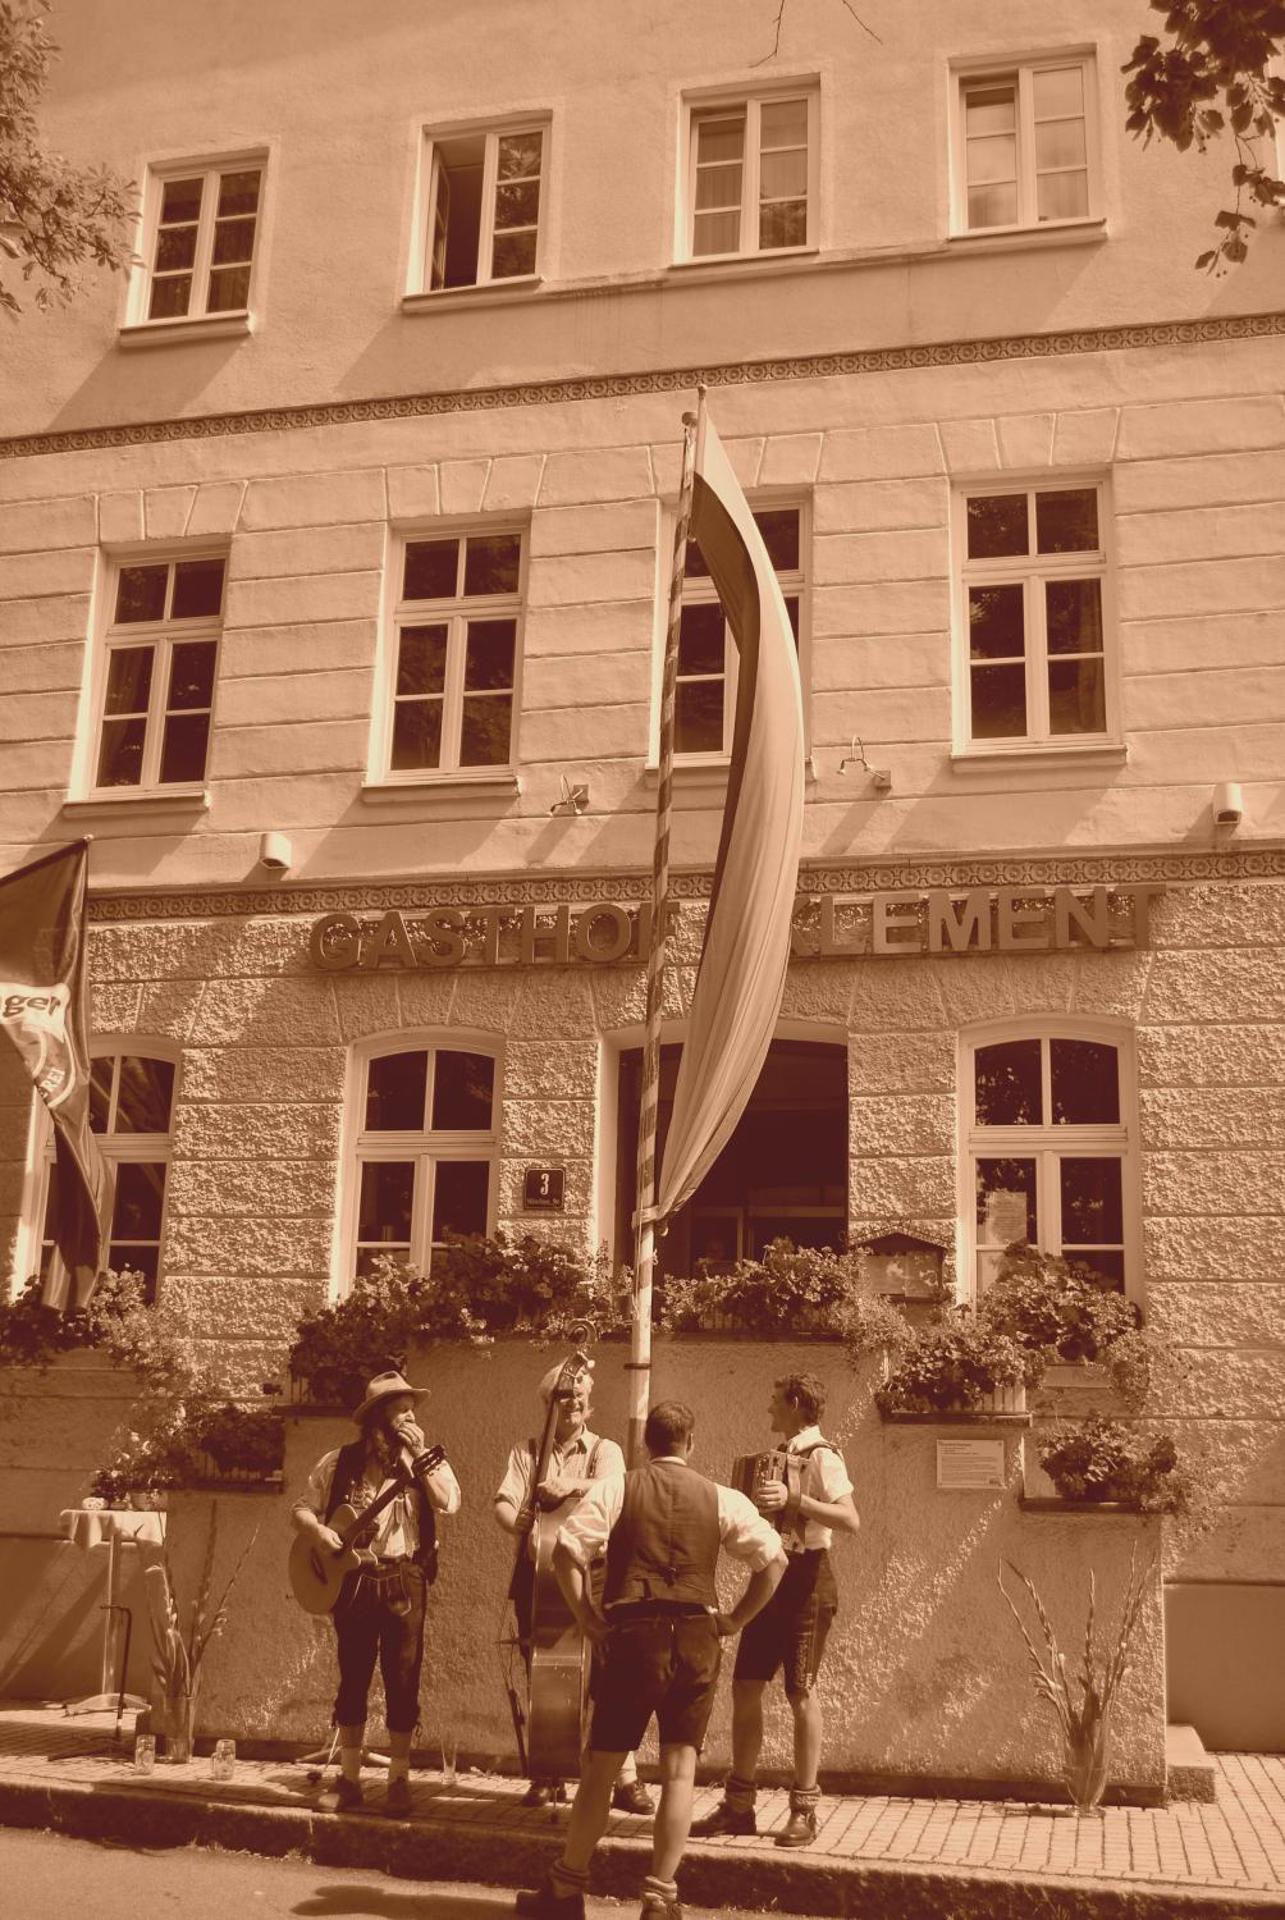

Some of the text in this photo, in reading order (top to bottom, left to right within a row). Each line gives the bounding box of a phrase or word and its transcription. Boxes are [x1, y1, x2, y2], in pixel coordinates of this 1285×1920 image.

[310, 902, 680, 970] GASTHOF
[0, 995, 61, 1017] ger
[540, 1173, 549, 1195] 3
